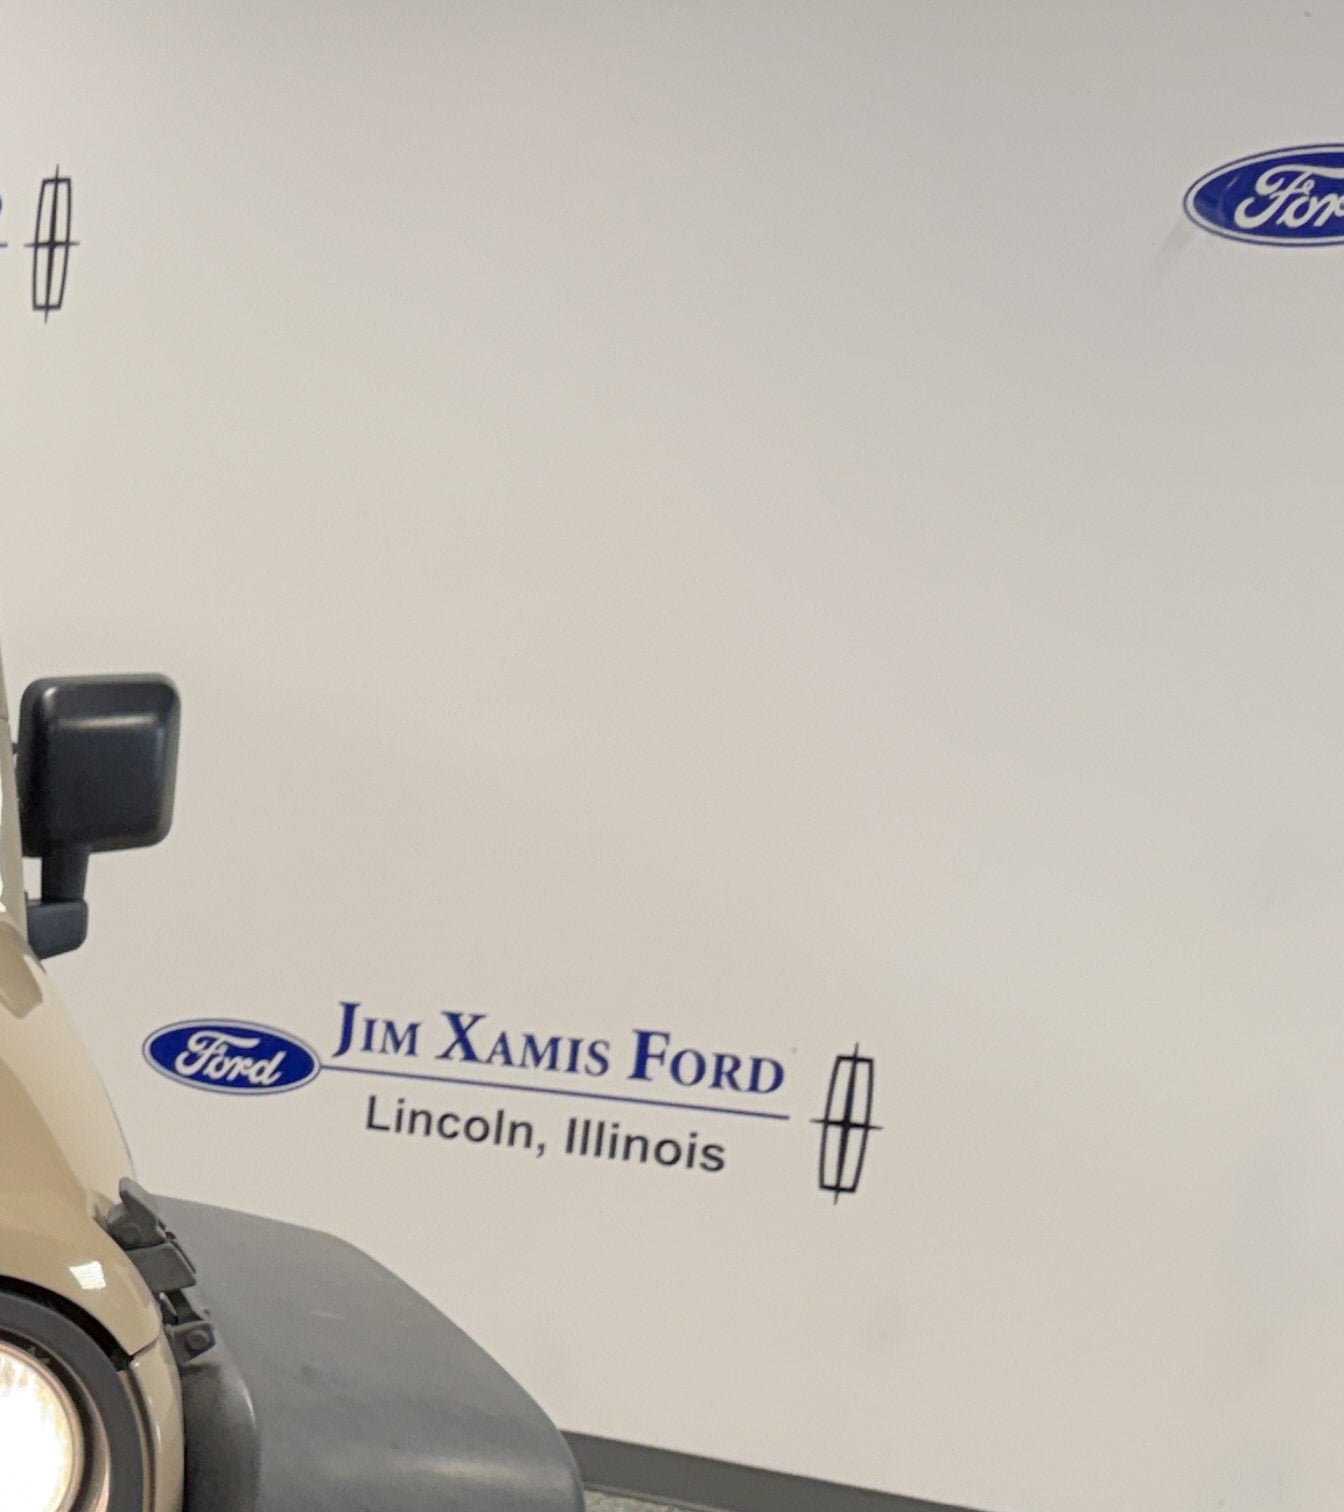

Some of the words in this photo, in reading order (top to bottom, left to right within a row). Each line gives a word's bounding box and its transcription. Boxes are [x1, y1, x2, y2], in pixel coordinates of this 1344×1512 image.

[1234, 164, 1344, 229] For
[174, 1028, 285, 1087] Ford
[331, 1001, 420, 1059] JIM
[435, 1010, 611, 1077] XAMIS
[627, 1029, 785, 1095] FORD
[365, 1094, 547, 1158] Lincoln,
[565, 1117, 726, 1173] Illinois
